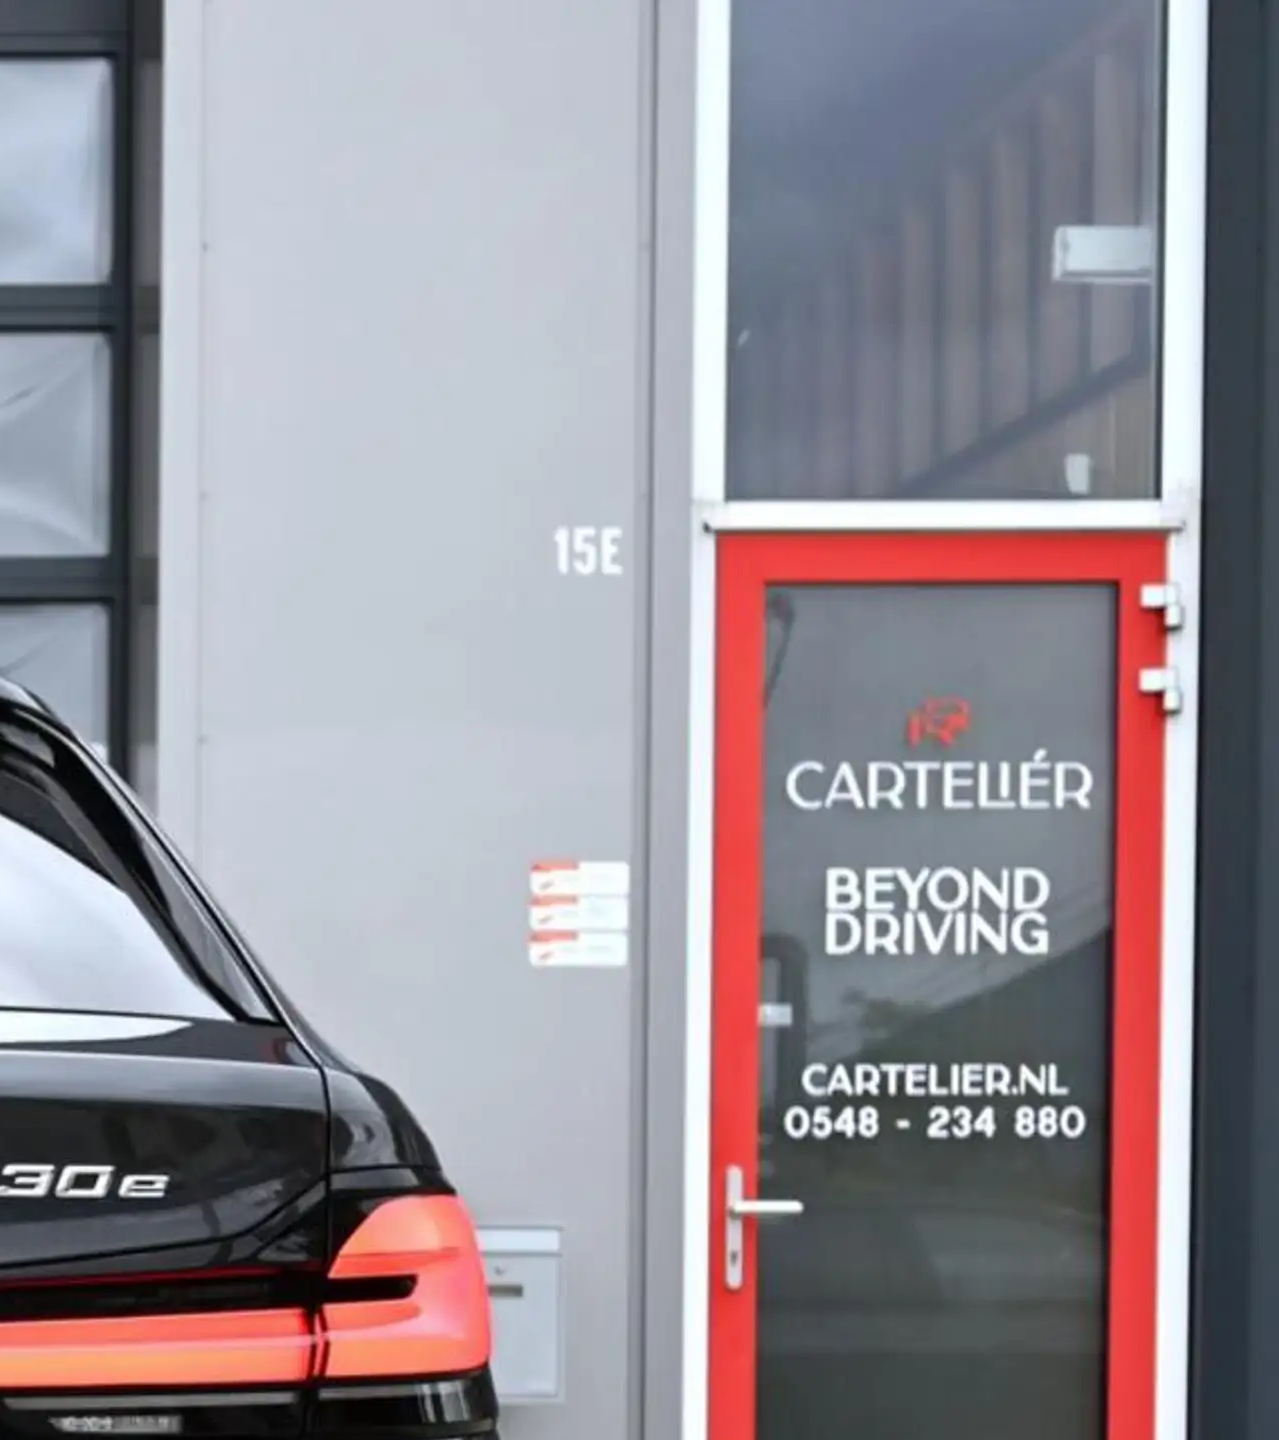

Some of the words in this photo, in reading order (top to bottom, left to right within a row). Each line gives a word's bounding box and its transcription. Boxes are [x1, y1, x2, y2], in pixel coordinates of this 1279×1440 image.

[553, 526, 623, 576] 15E
[825, 866, 1050, 911] BEYOND
[825, 911, 1050, 955] DRIVING
[801, 1062, 1070, 1098] CARTELIER.NL
[783, 1105, 880, 1139] 0548
[927, 1105, 996, 1139] 234
[1014, 1105, 1087, 1139] 880
